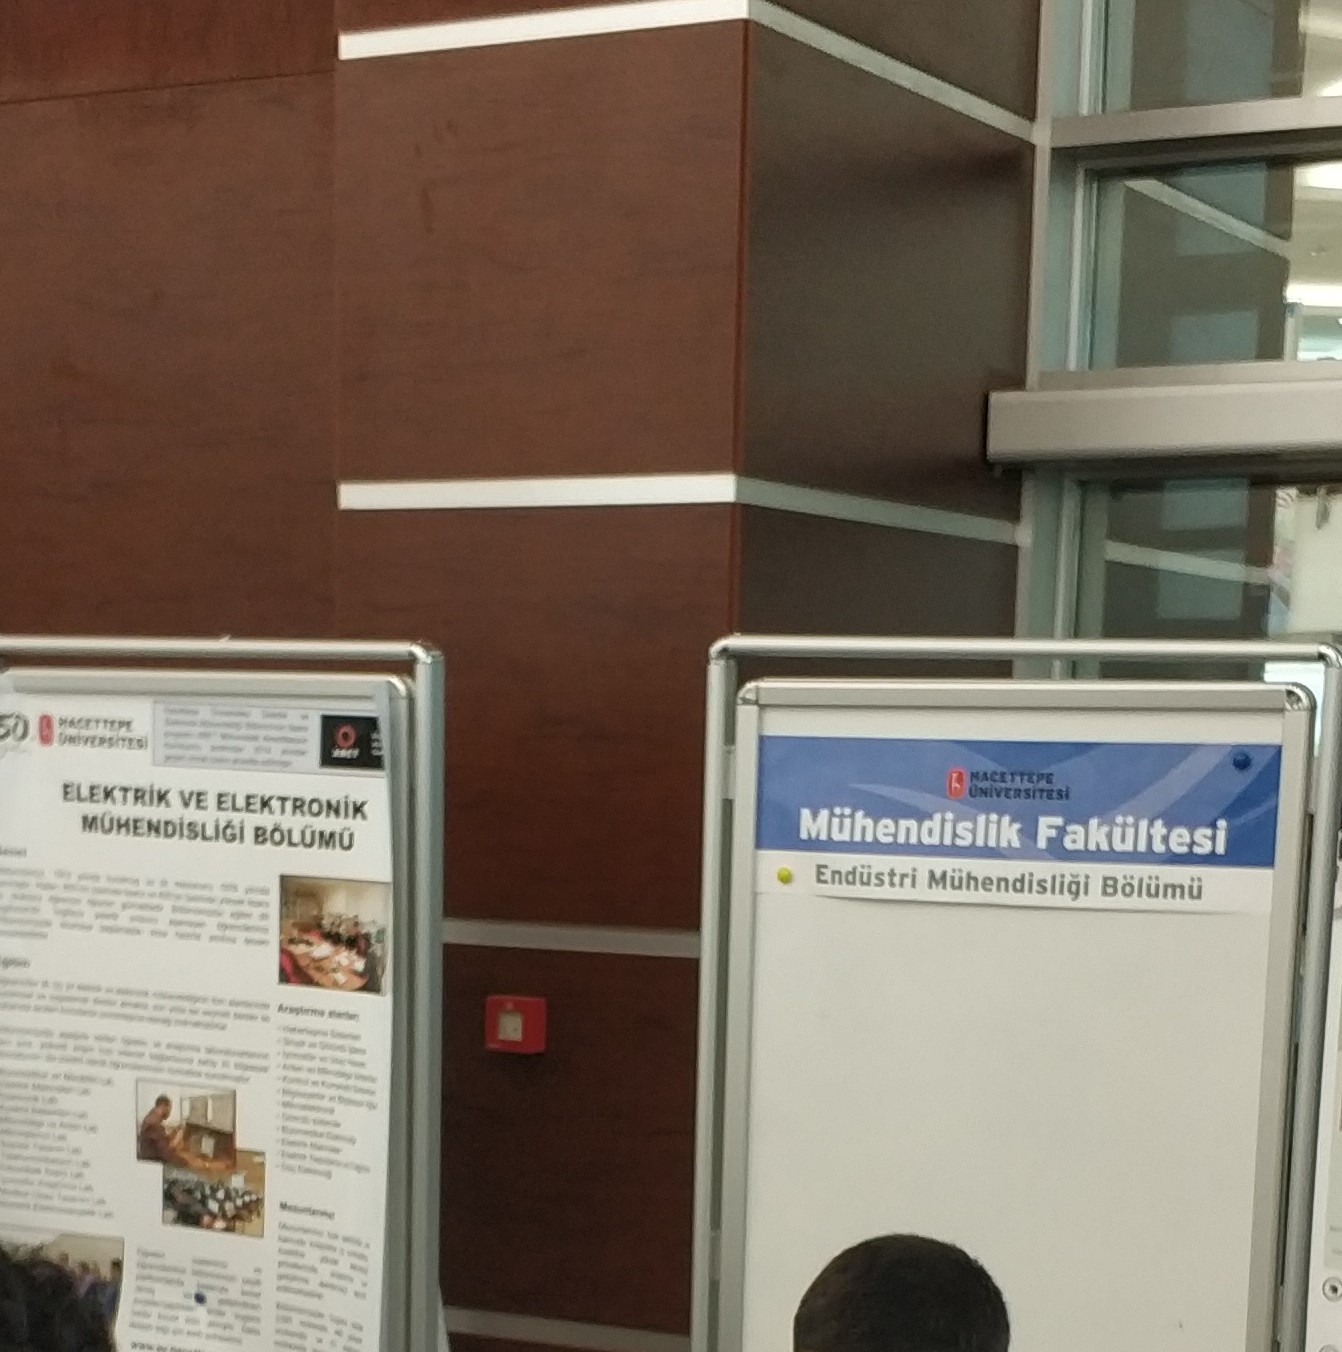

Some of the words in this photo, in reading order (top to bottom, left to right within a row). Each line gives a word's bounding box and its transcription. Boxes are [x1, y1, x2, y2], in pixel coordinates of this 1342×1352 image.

[969, 784, 1070, 800] ÜNİVERSİTESİ
[970, 771, 1054, 785] HACETTEPE
[62, 782, 172, 808] ELEKTRİK
[179, 789, 209, 811] VE
[216, 793, 370, 821] ELEKTRONİK
[81, 811, 246, 844] MÜHENDİSLİĞİ
[254, 823, 356, 851] BÖLÜMÜ
[799, 807, 1022, 848] Mühendislik
[1036, 814, 1227, 856] Fakültesi
[815, 864, 918, 889] Endüstri
[928, 868, 1090, 901] Mühendisliği
[1101, 875, 1202, 900] Bölümü
